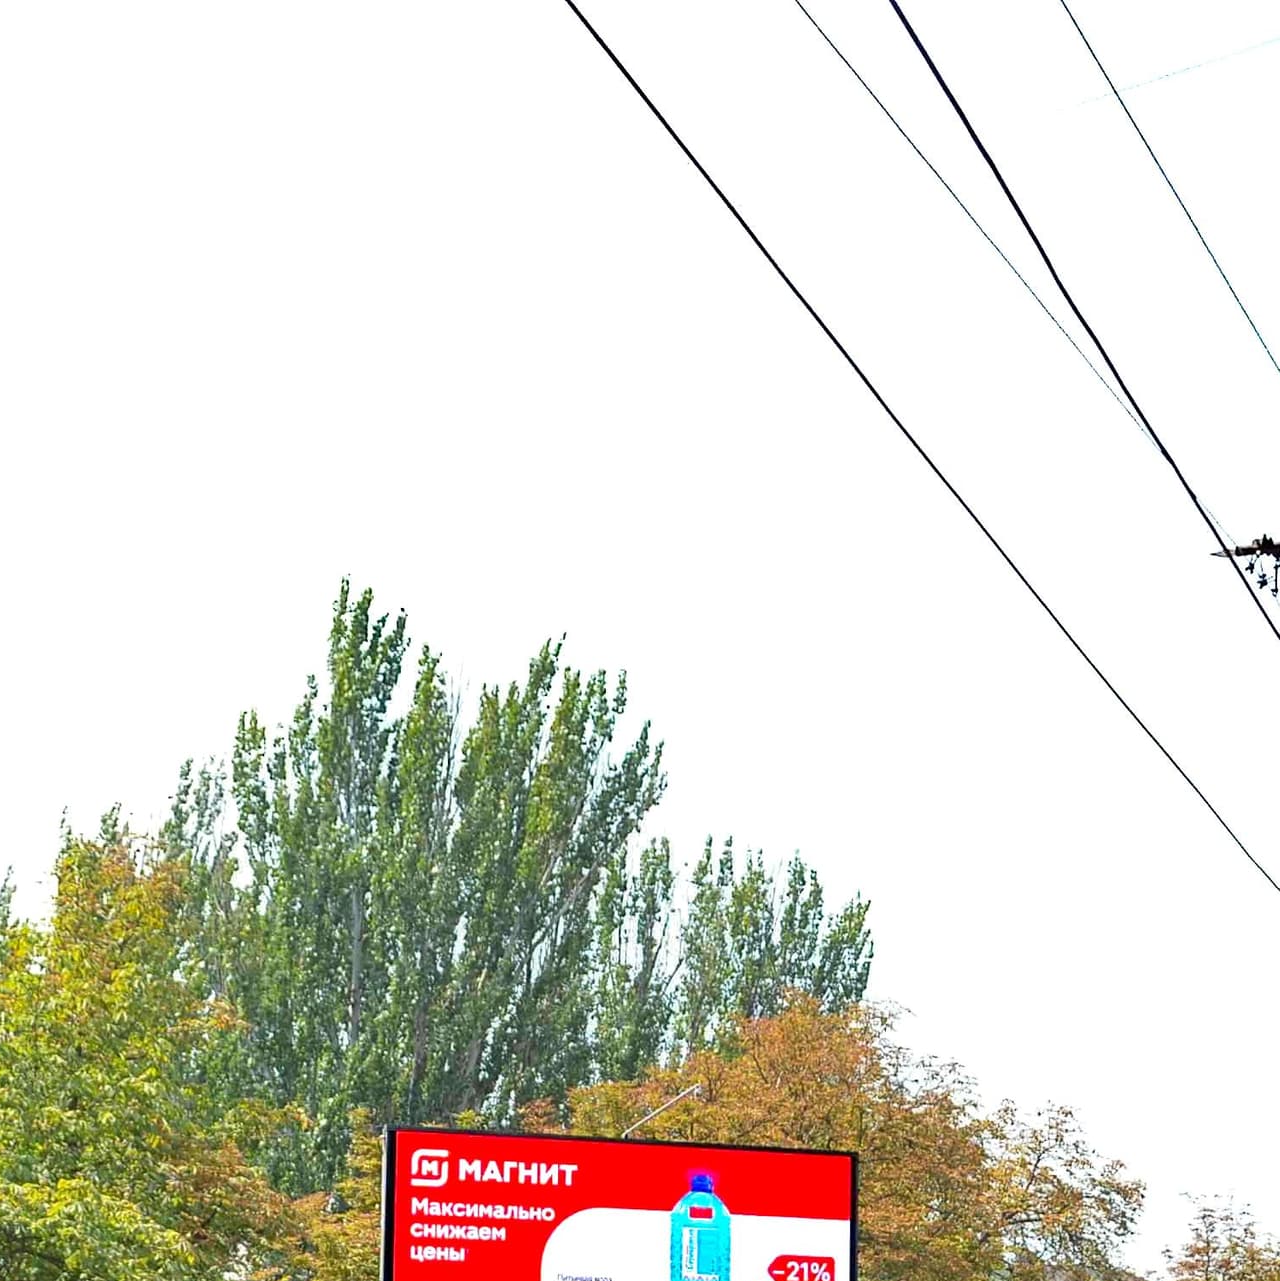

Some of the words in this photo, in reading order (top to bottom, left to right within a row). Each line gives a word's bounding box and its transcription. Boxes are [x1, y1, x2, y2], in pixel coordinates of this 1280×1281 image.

[458, 1158, 578, 1186] МАГНИТ
[411, 1197, 556, 1222] Максимально
[410, 1222, 507, 1241] снижаем
[410, 1245, 466, 1262] цены
